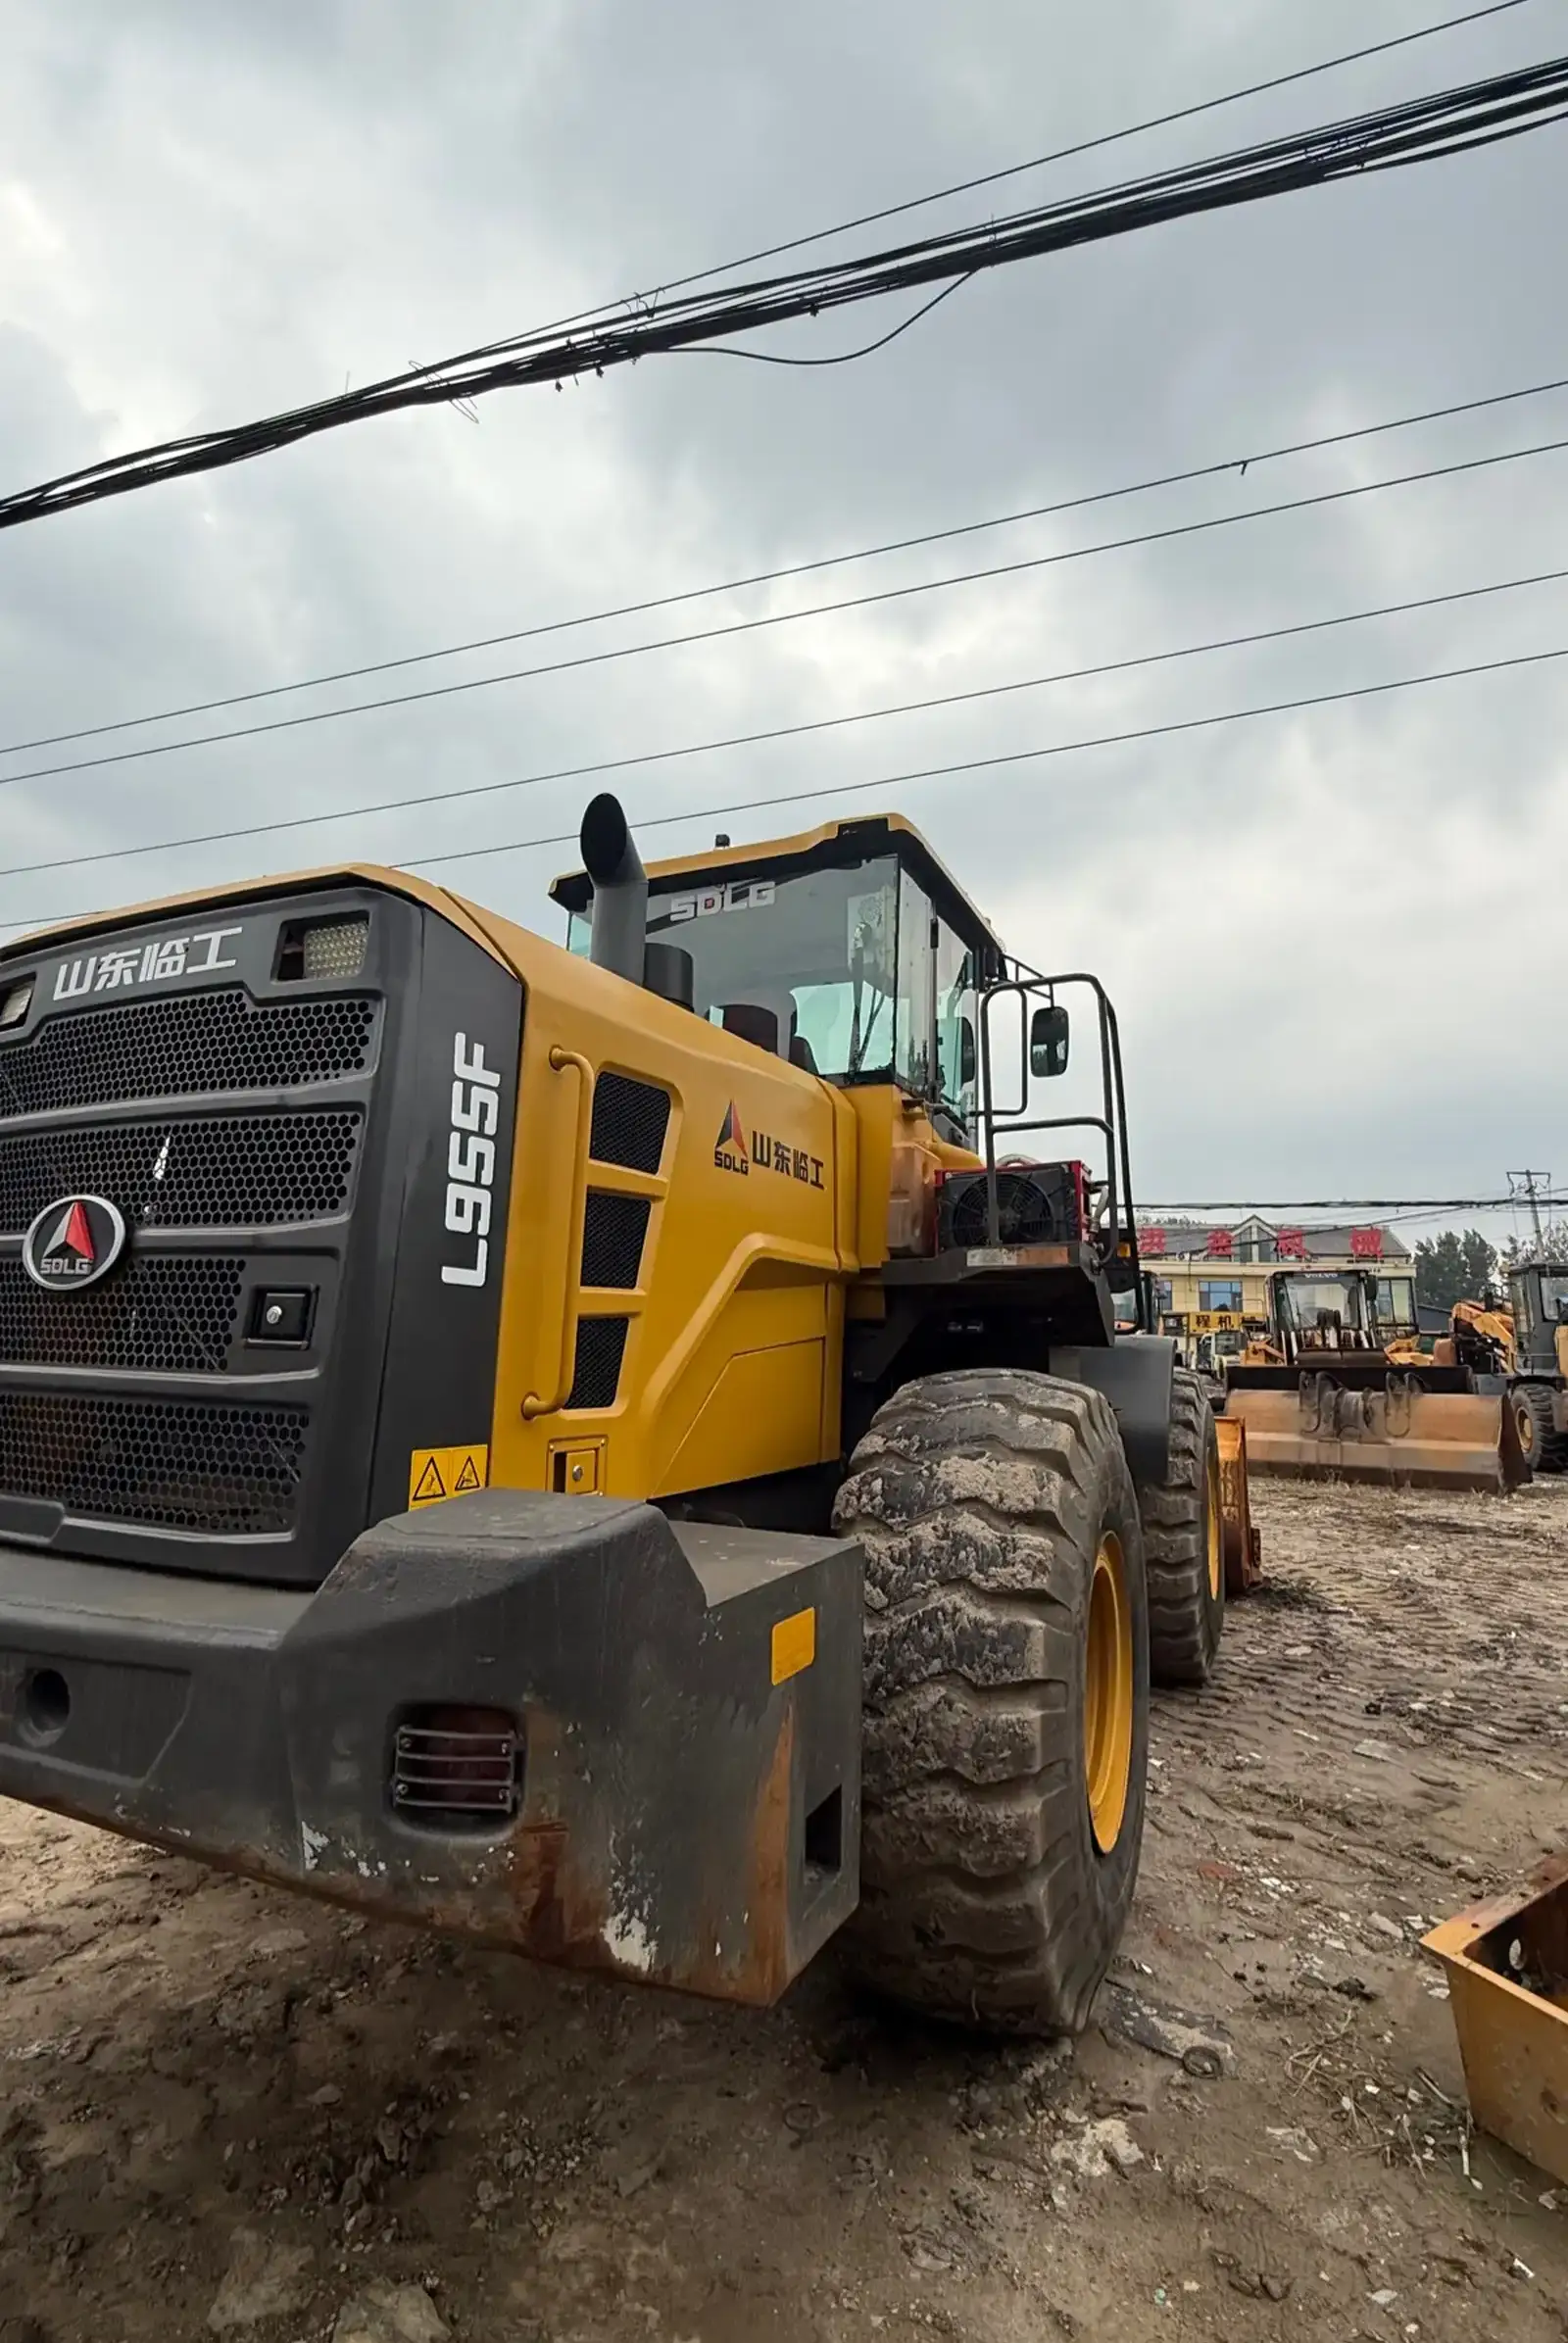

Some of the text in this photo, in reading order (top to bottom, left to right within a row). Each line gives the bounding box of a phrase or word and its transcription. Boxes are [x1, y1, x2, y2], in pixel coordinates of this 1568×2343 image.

[669, 881, 775, 921] SDLG
[53, 927, 243, 1001] 山东临工
[441, 1032, 501, 1287] L955F
[714, 1150, 749, 1176] SDLG
[752, 1130, 825, 1191] 山东临工
[40, 1257, 94, 1275] SDLG
